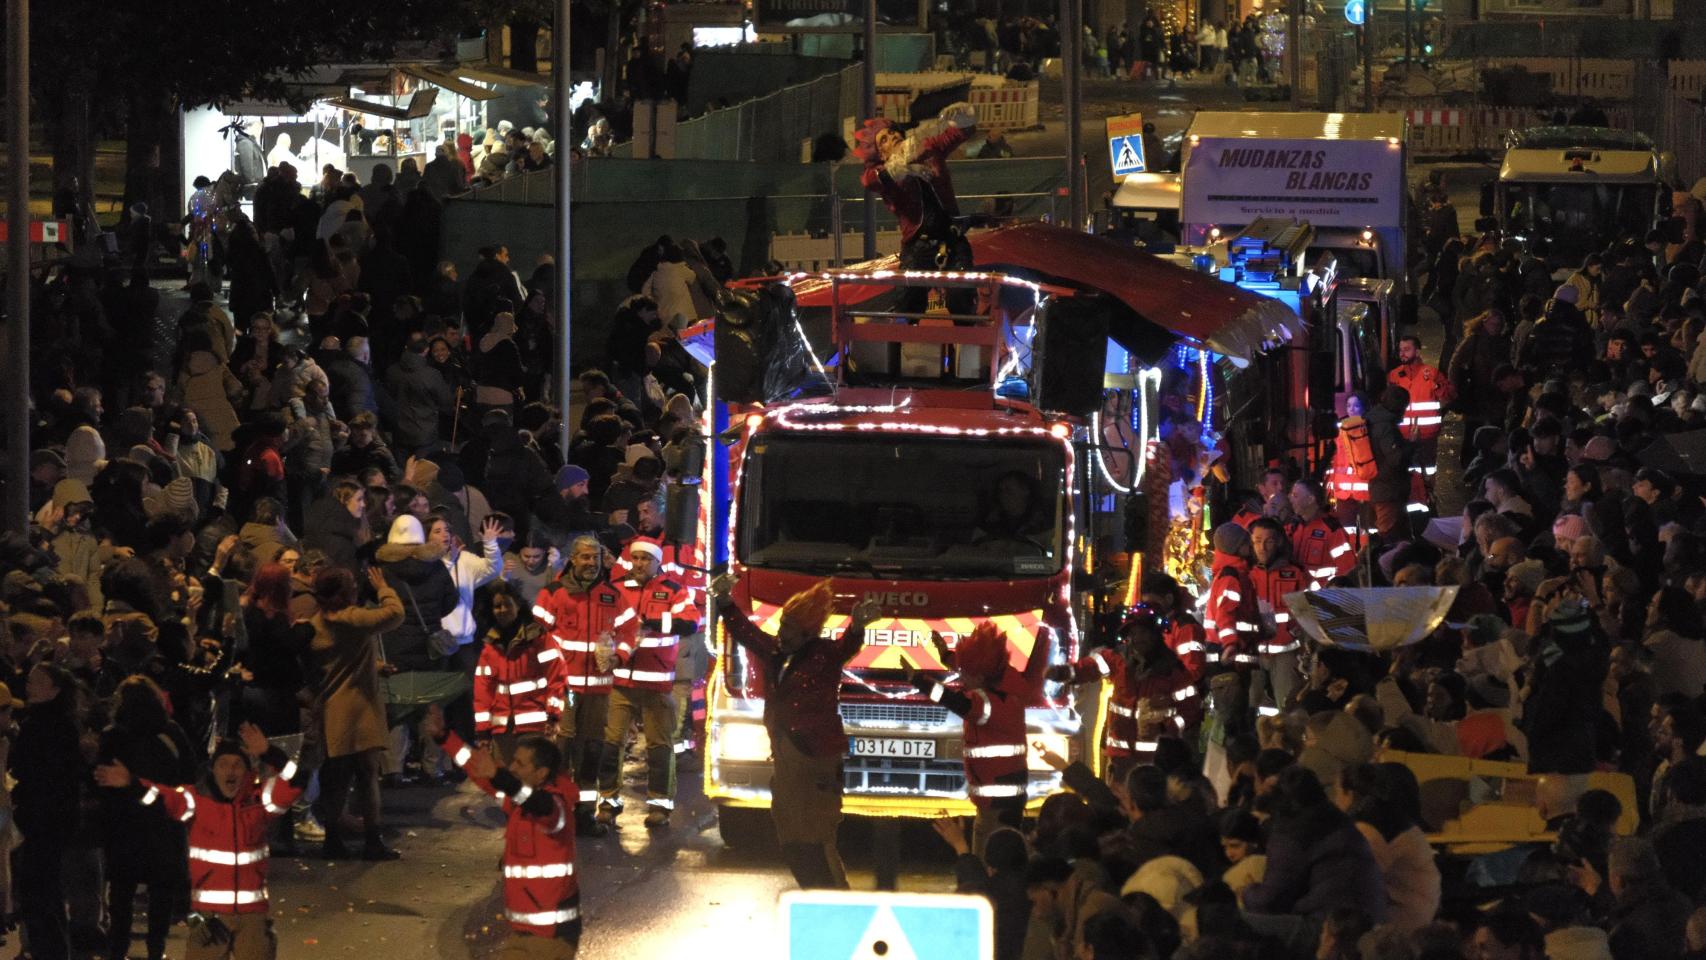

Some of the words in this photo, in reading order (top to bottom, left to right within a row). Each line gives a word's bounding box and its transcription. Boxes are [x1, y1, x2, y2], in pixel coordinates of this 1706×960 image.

[1219, 149, 1326, 169] MUDANZAS
[1285, 171, 1372, 191] BLANCAS
[1240, 206, 1285, 214] Servicio
[1299, 207, 1340, 215] medida
[863, 591, 928, 606] IVECO
[857, 739, 896, 754] 0314
[903, 740, 933, 756] DTZ
